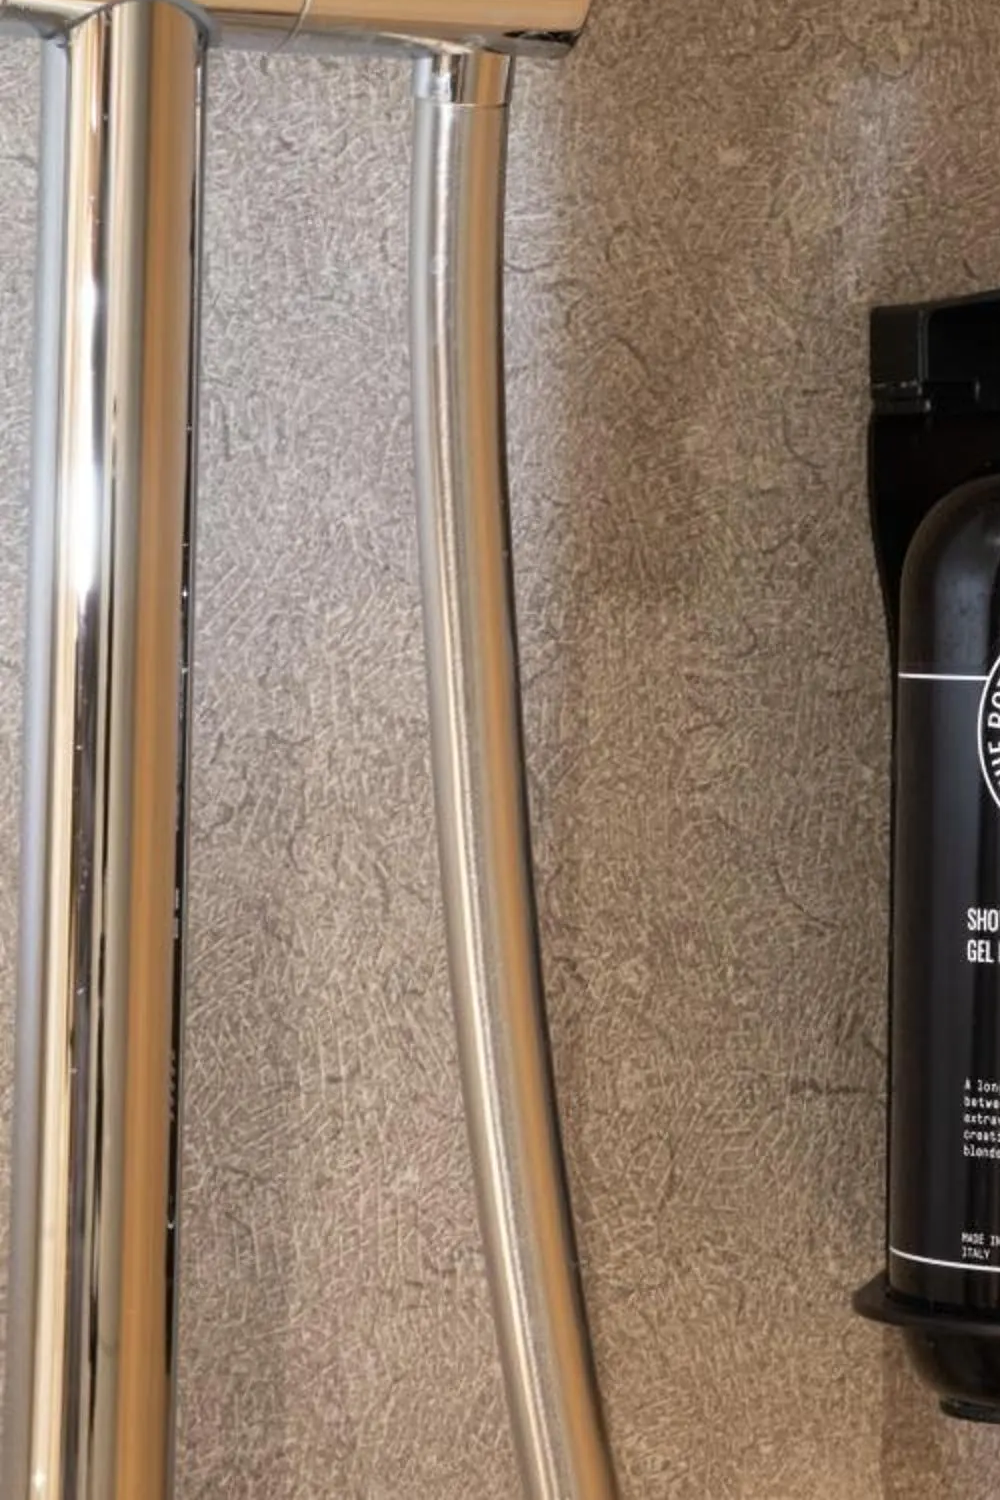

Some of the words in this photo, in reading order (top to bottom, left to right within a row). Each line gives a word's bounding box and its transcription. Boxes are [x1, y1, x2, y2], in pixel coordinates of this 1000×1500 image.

[967, 939, 994, 964] GEL
[964, 1078, 971, 1090] A
[962, 1232, 984, 1245] MADE
[962, 1246, 990, 1260] ITALY
